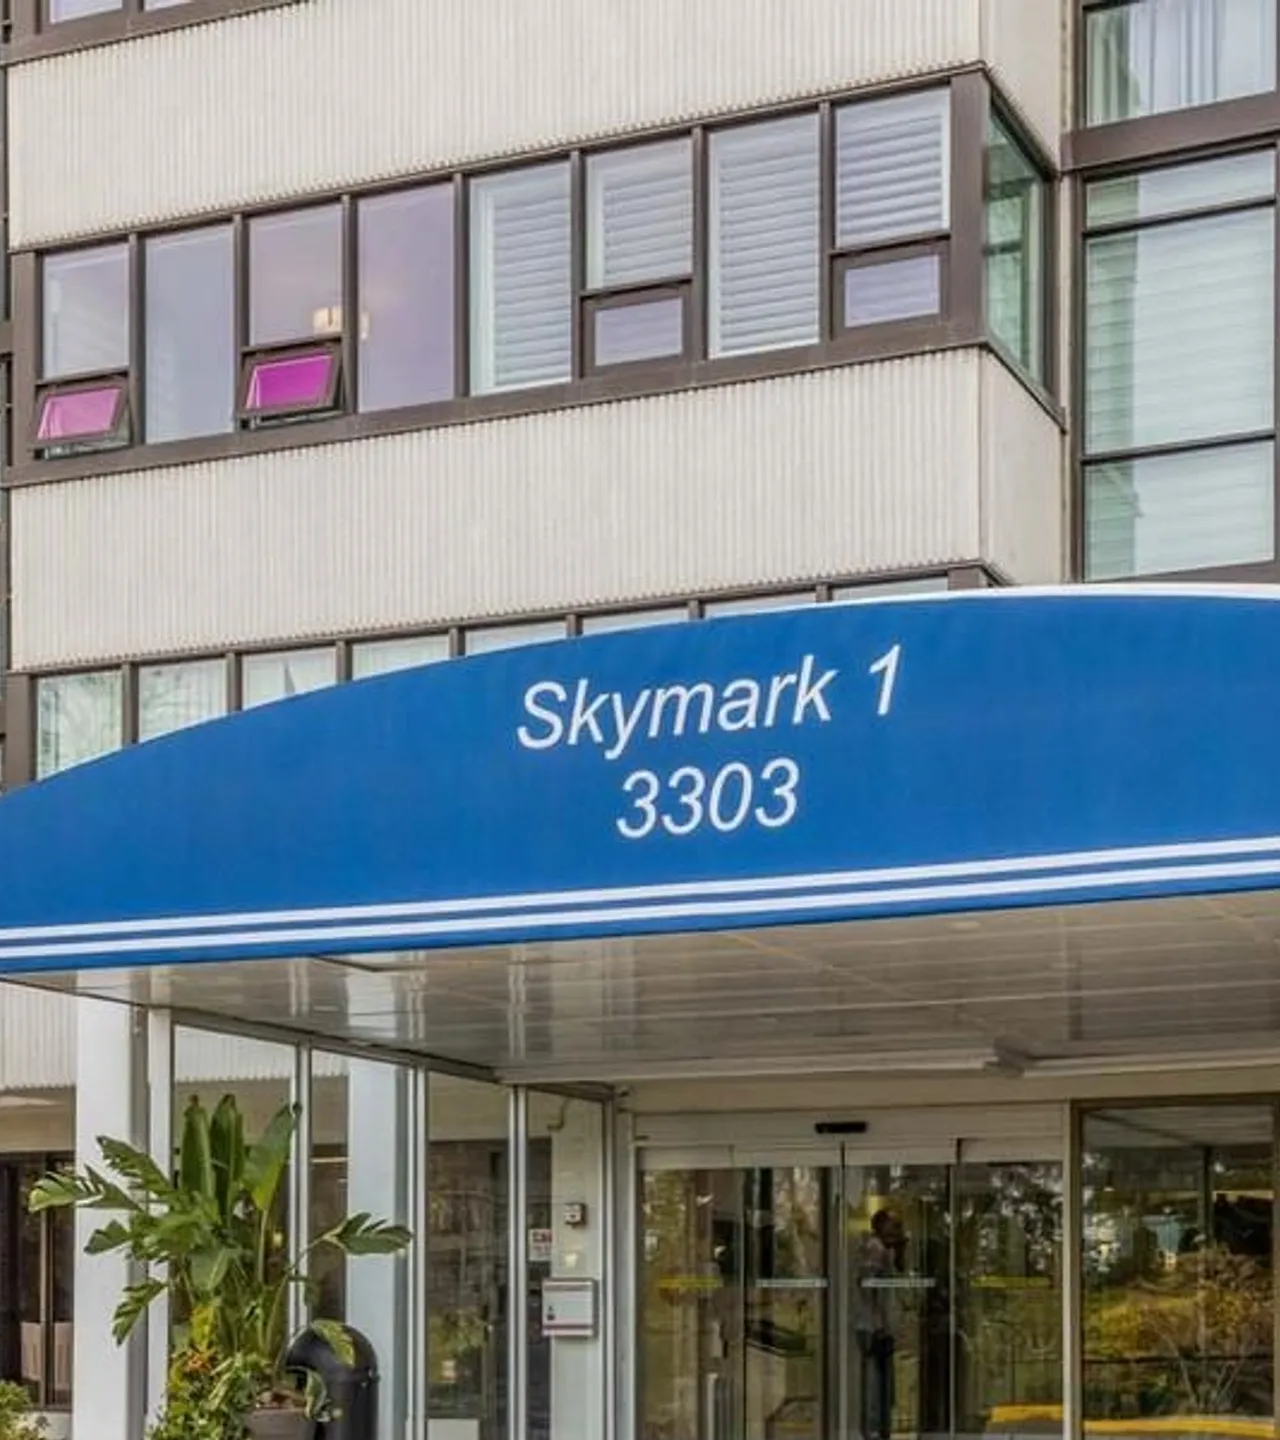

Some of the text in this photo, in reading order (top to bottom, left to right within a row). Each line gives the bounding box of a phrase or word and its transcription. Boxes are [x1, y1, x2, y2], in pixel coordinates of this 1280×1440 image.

[516, 643, 902, 761] Skymark 1
[615, 756, 801, 839] 3303
